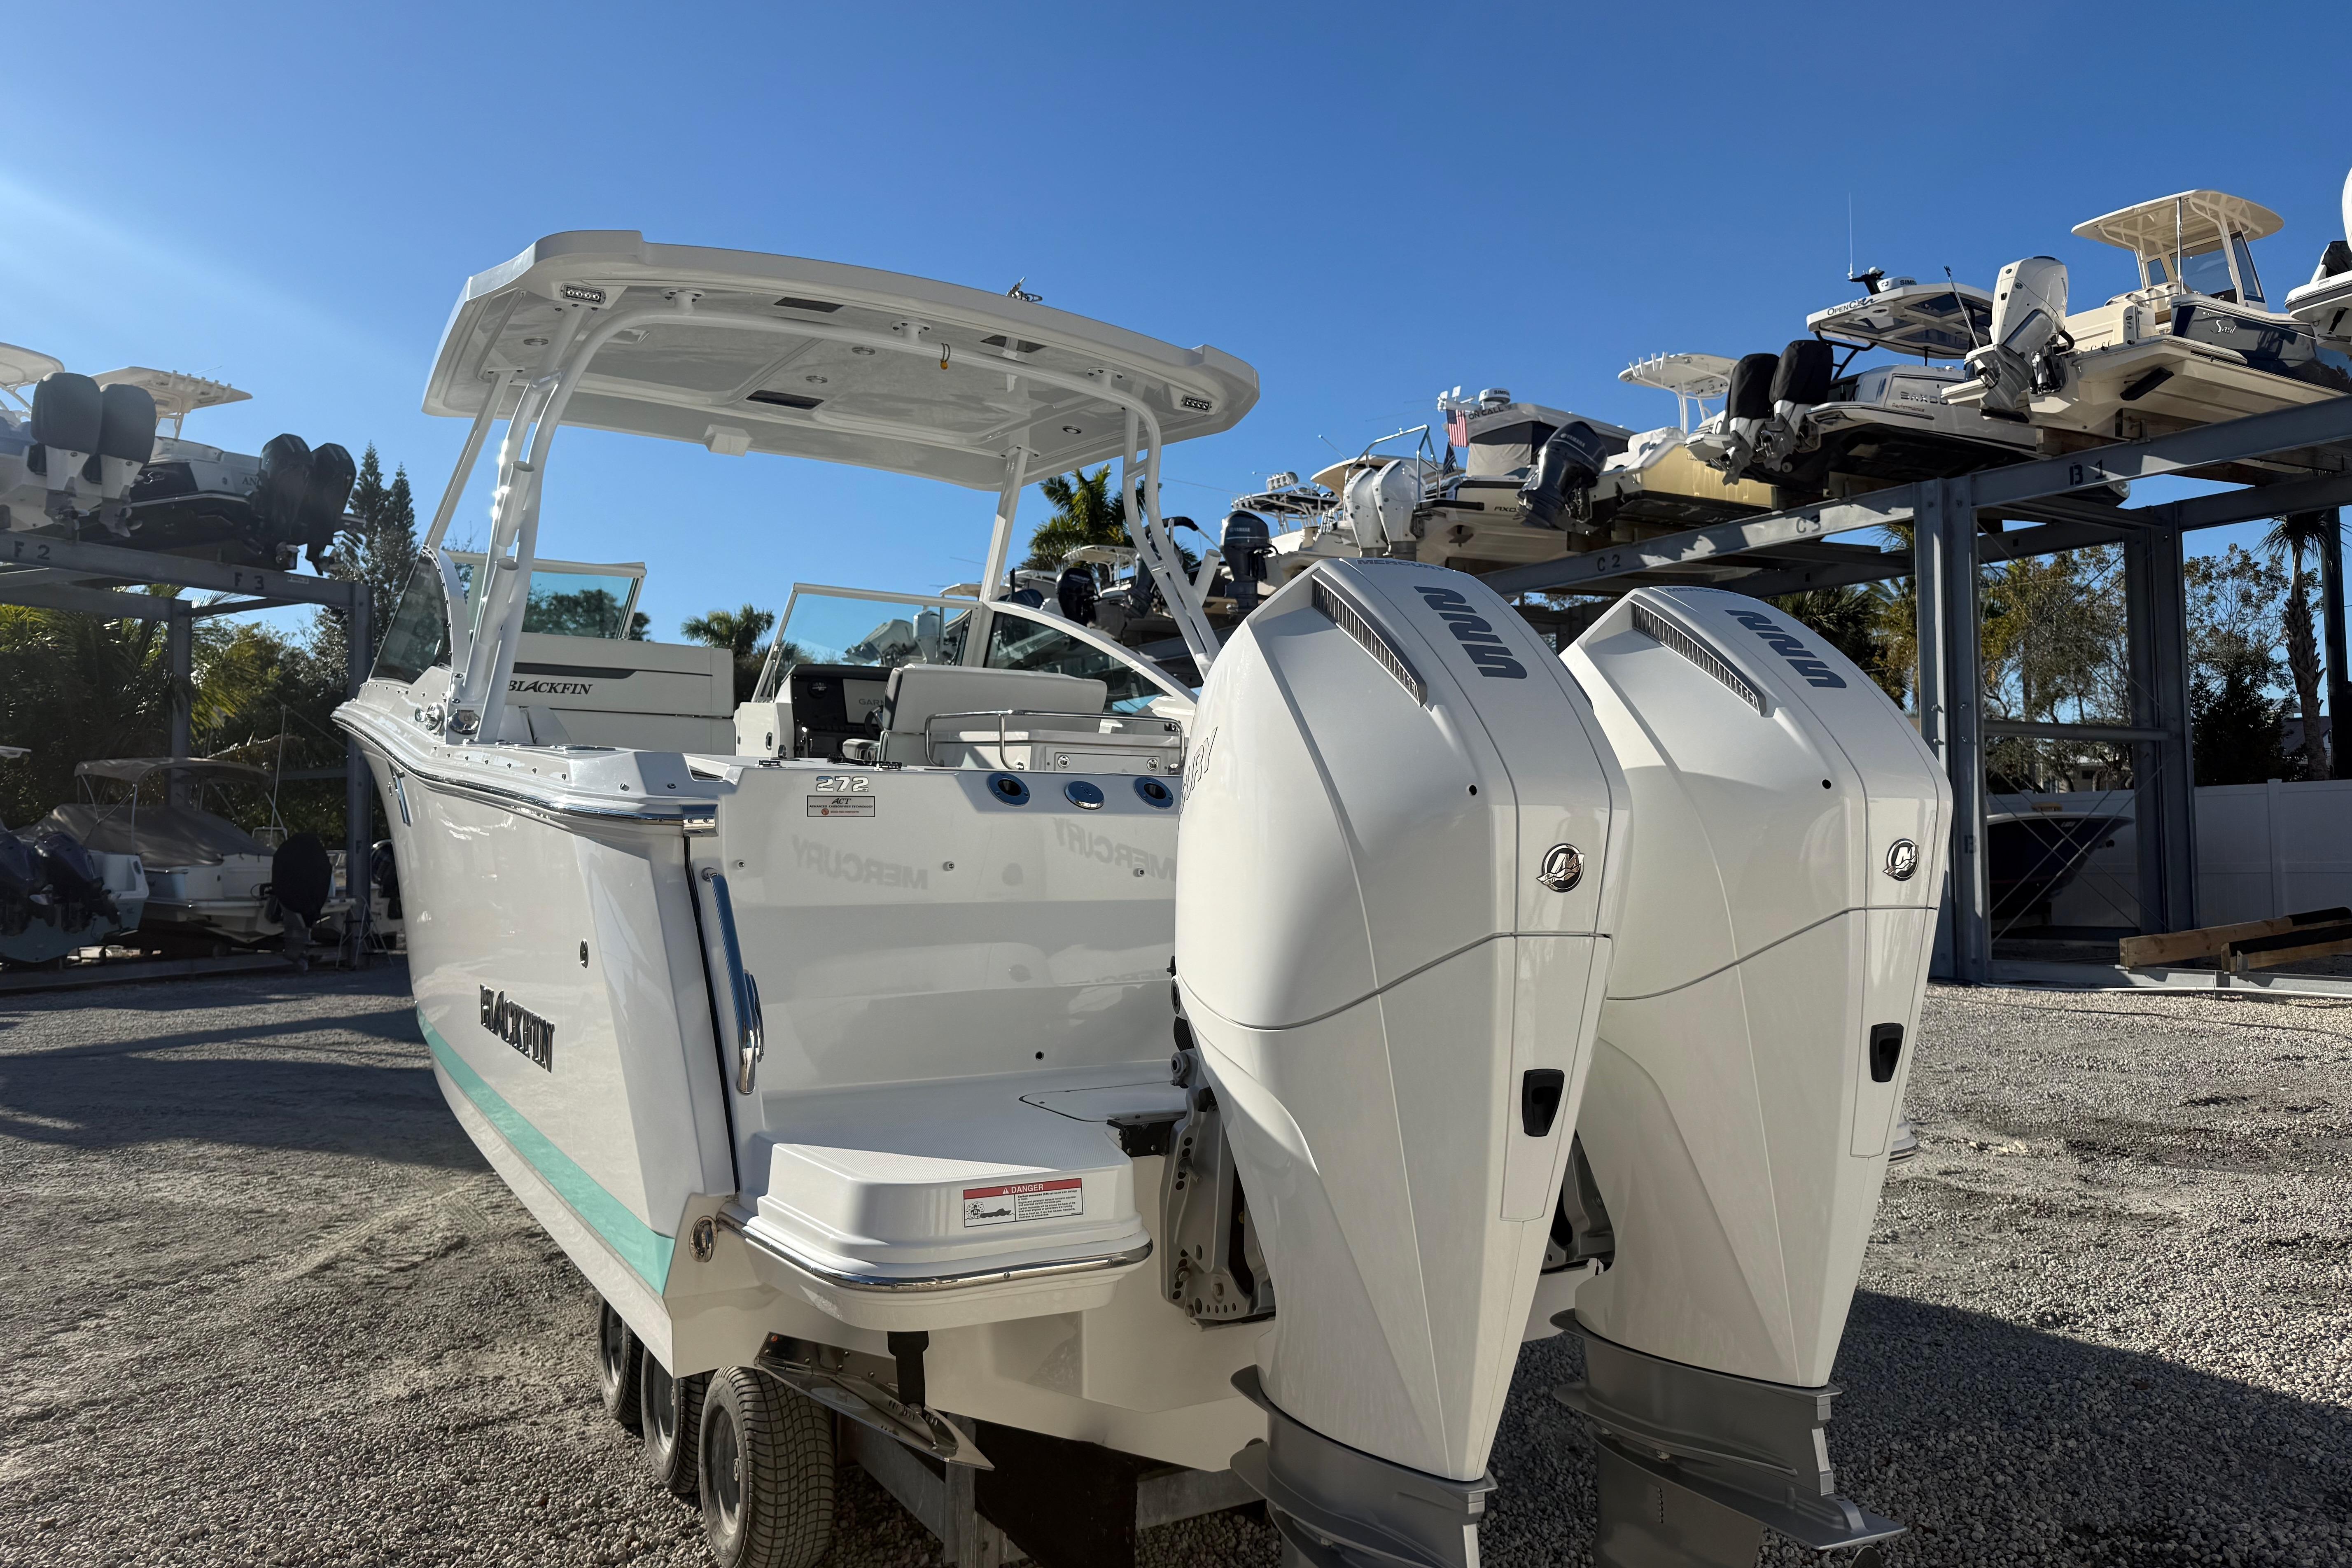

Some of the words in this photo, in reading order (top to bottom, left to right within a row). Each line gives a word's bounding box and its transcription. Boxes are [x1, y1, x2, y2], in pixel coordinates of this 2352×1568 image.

[1481, 407, 1504, 416] CALL
[2069, 463, 2083, 485] B
[2095, 459, 2107, 479] 1
[1796, 518, 1806, 534] C
[14, 540, 24, 558] F
[37, 544, 50, 560] 2
[1597, 556, 1605, 572] C
[1612, 554, 1621, 568] 2
[234, 572, 243, 587] F
[254, 575, 264, 590] 3
[1413, 586, 1527, 679] 225
[1724, 609, 1847, 688] 225
[508, 680, 593, 695] BLACKFIN
[816, 776, 869, 792] 272
[1011, 1183, 1043, 1193] DANGER
